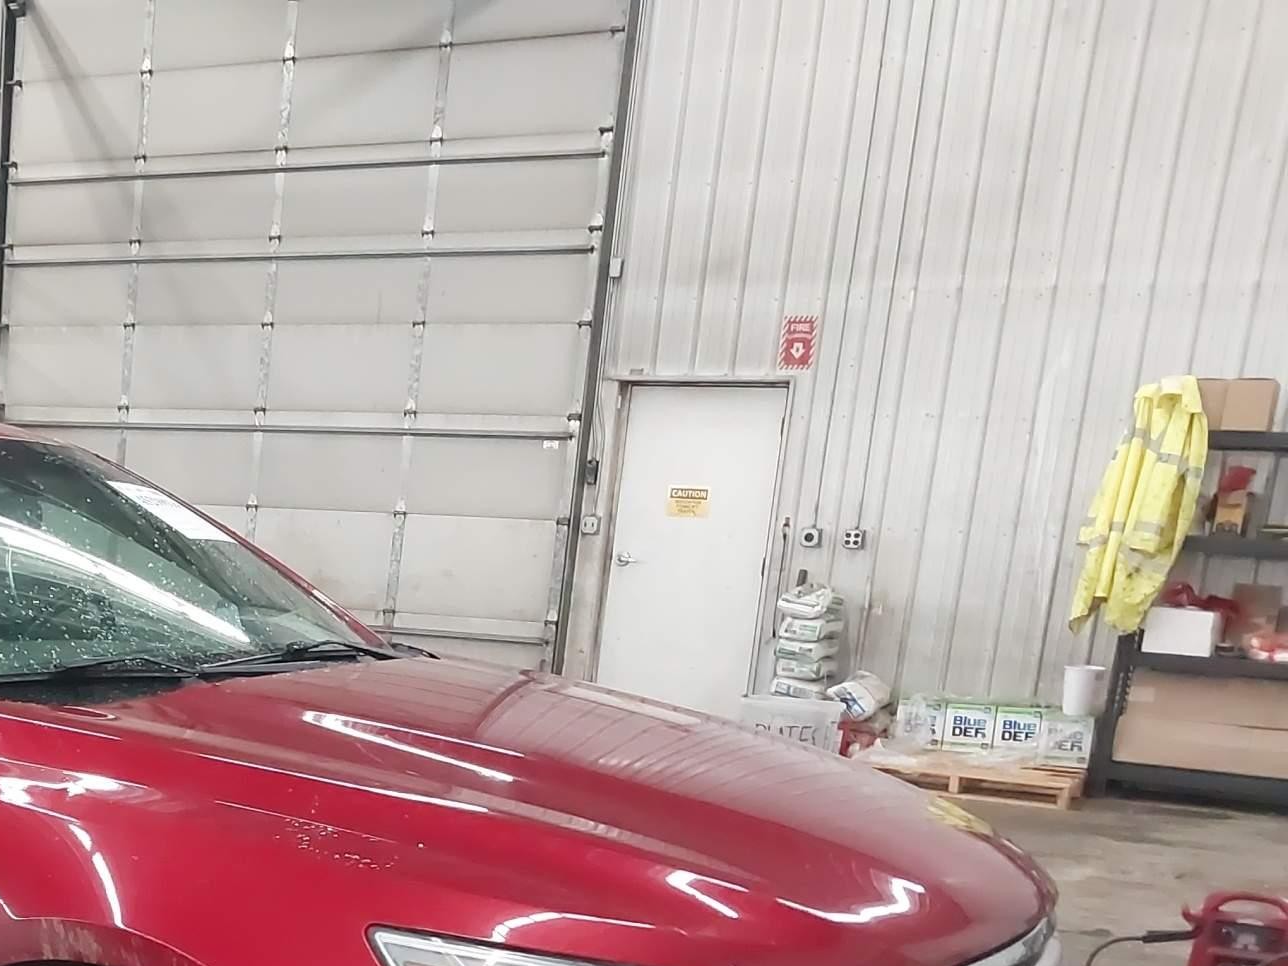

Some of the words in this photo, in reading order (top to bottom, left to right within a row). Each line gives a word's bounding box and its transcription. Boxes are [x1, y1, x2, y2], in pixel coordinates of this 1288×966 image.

[790, 323, 811, 332] FIRE
[671, 489, 707, 499] CAUTION
[953, 715, 987, 727] Blue
[1002, 719, 1037, 731] Blue
[1001, 730, 1035, 742] DEF
